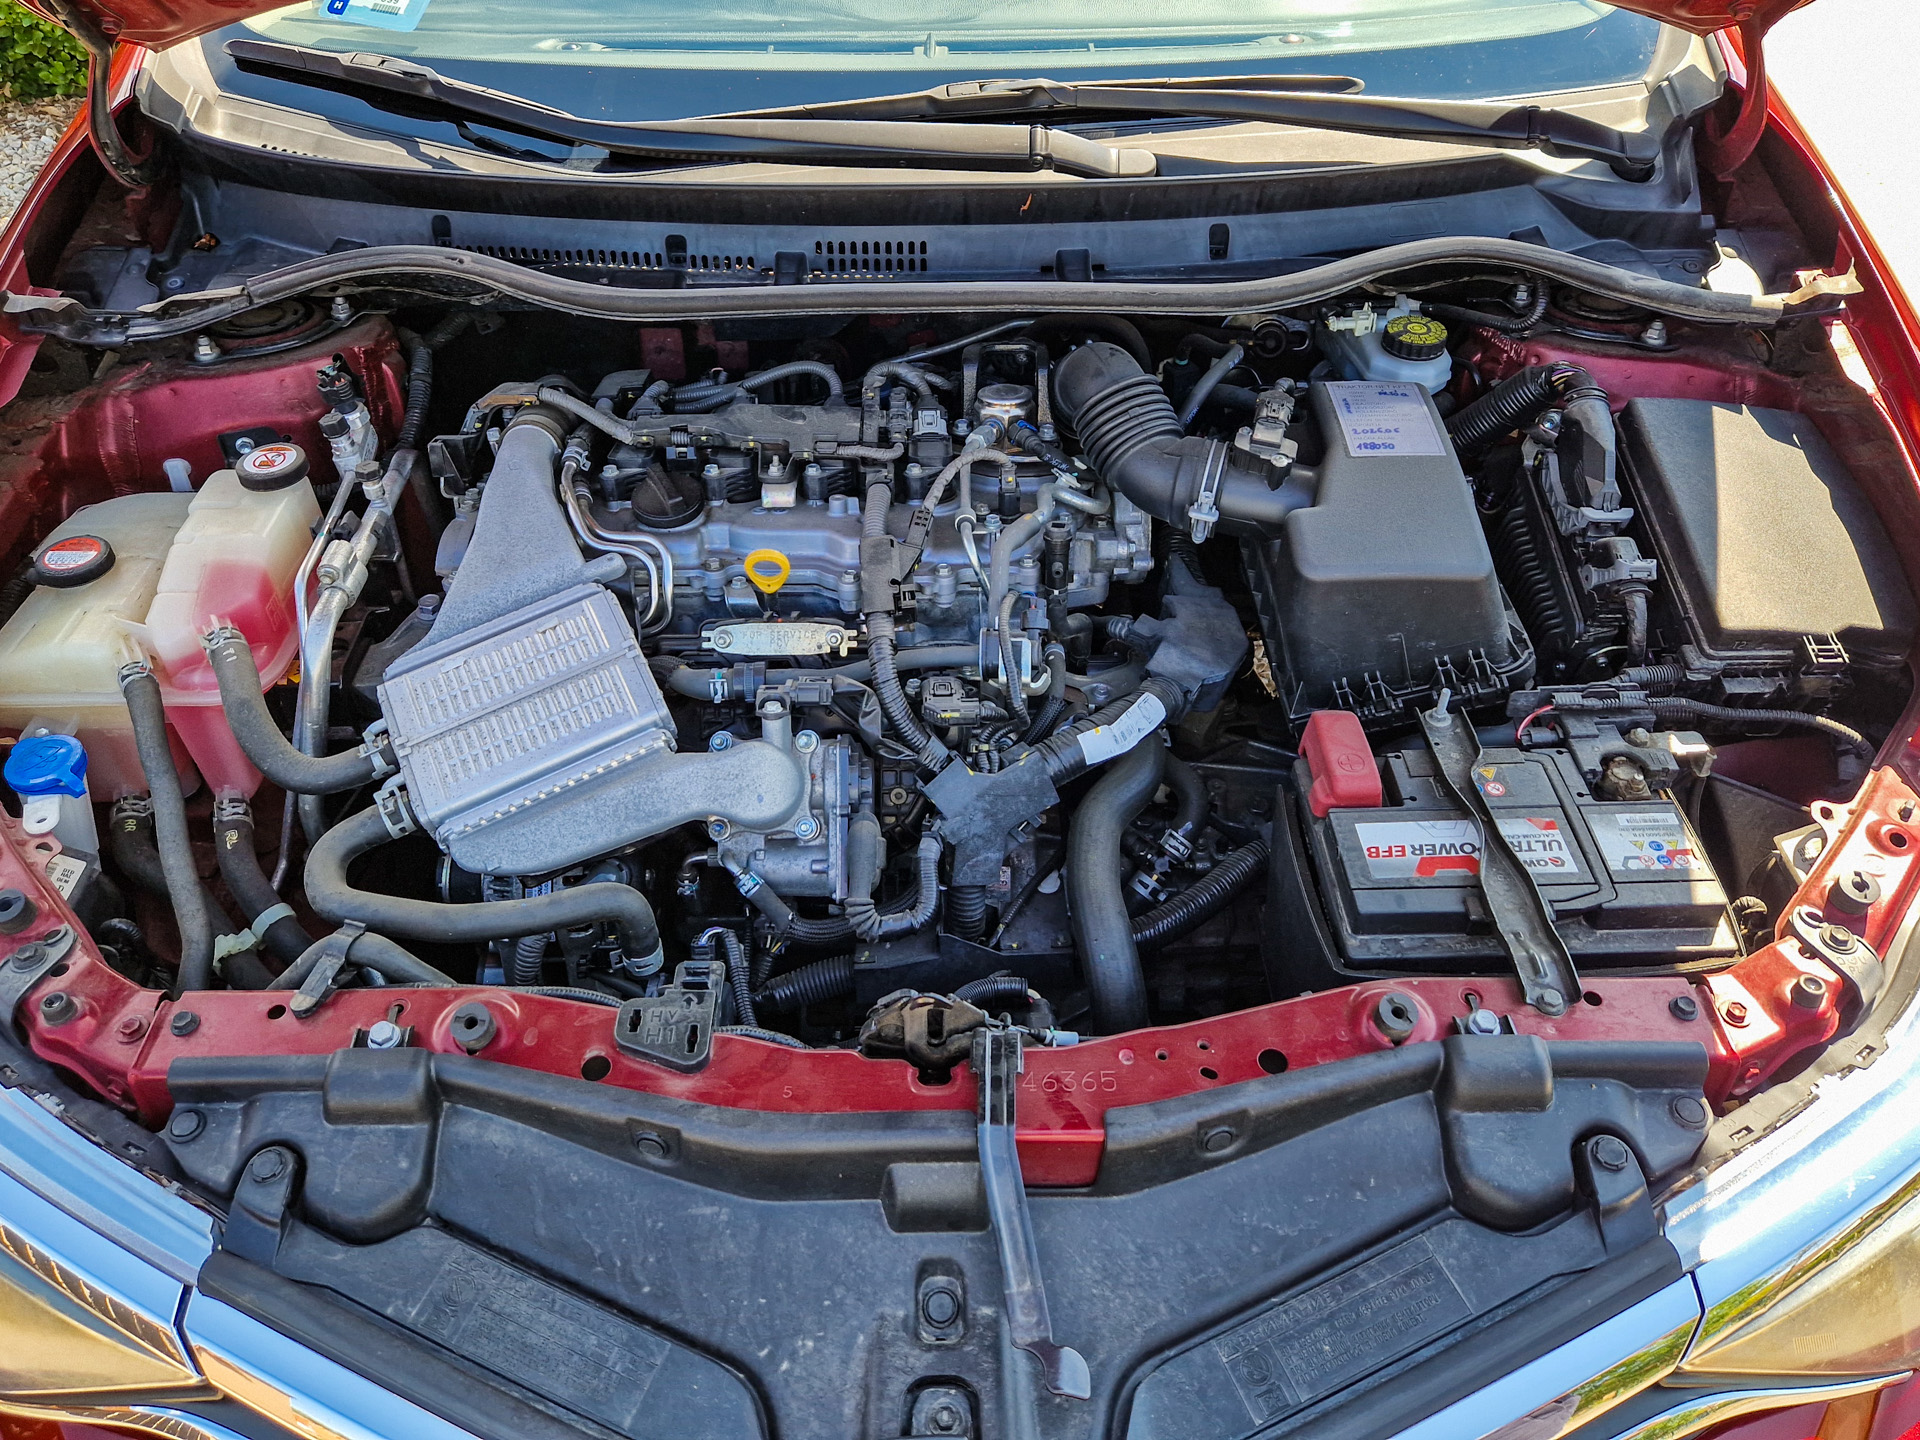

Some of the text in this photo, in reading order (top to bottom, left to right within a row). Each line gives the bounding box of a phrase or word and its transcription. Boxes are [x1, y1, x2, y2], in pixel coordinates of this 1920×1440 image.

[333, 1, 344, 10] H
[769, 630, 817, 639] SERVICE
[1366, 839, 1564, 859] ULTR OWER EFB
[1022, 1070, 1117, 1092] 46365
[782, 1085, 793, 1099] 5
